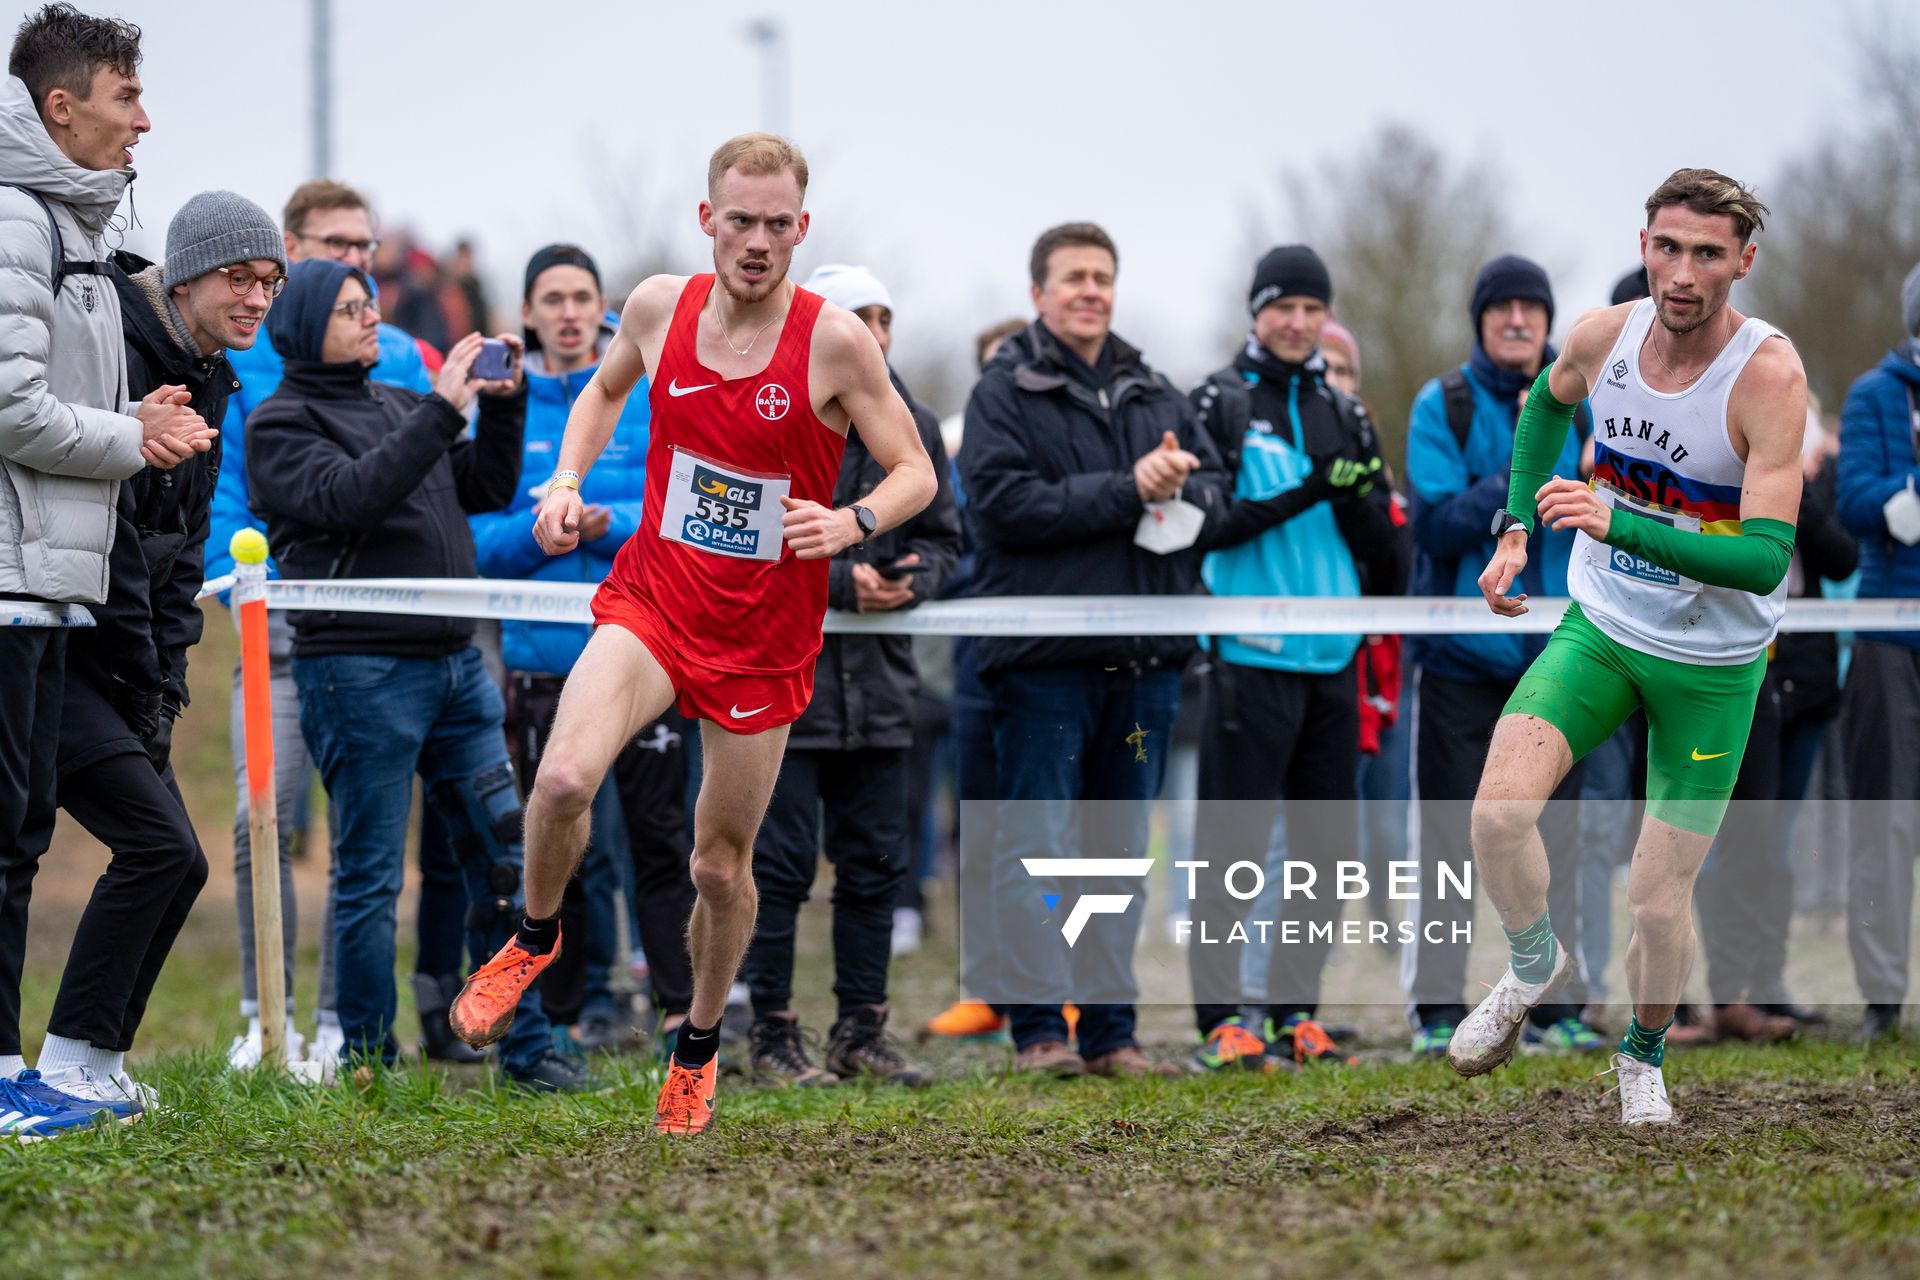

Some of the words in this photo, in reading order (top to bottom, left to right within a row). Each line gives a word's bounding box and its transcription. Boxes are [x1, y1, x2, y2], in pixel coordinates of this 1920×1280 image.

[1606, 378, 1626, 390] Ronhill
[758, 398, 787, 406] BAYER
[1605, 417, 1689, 463] HANAU
[726, 487, 756, 504] GLS
[695, 496, 750, 530] 535
[712, 528, 755, 546] PLAN
[711, 541, 753, 552] INTERNATIONAL
[1636, 571, 1676, 583] INTERNATIONAL
